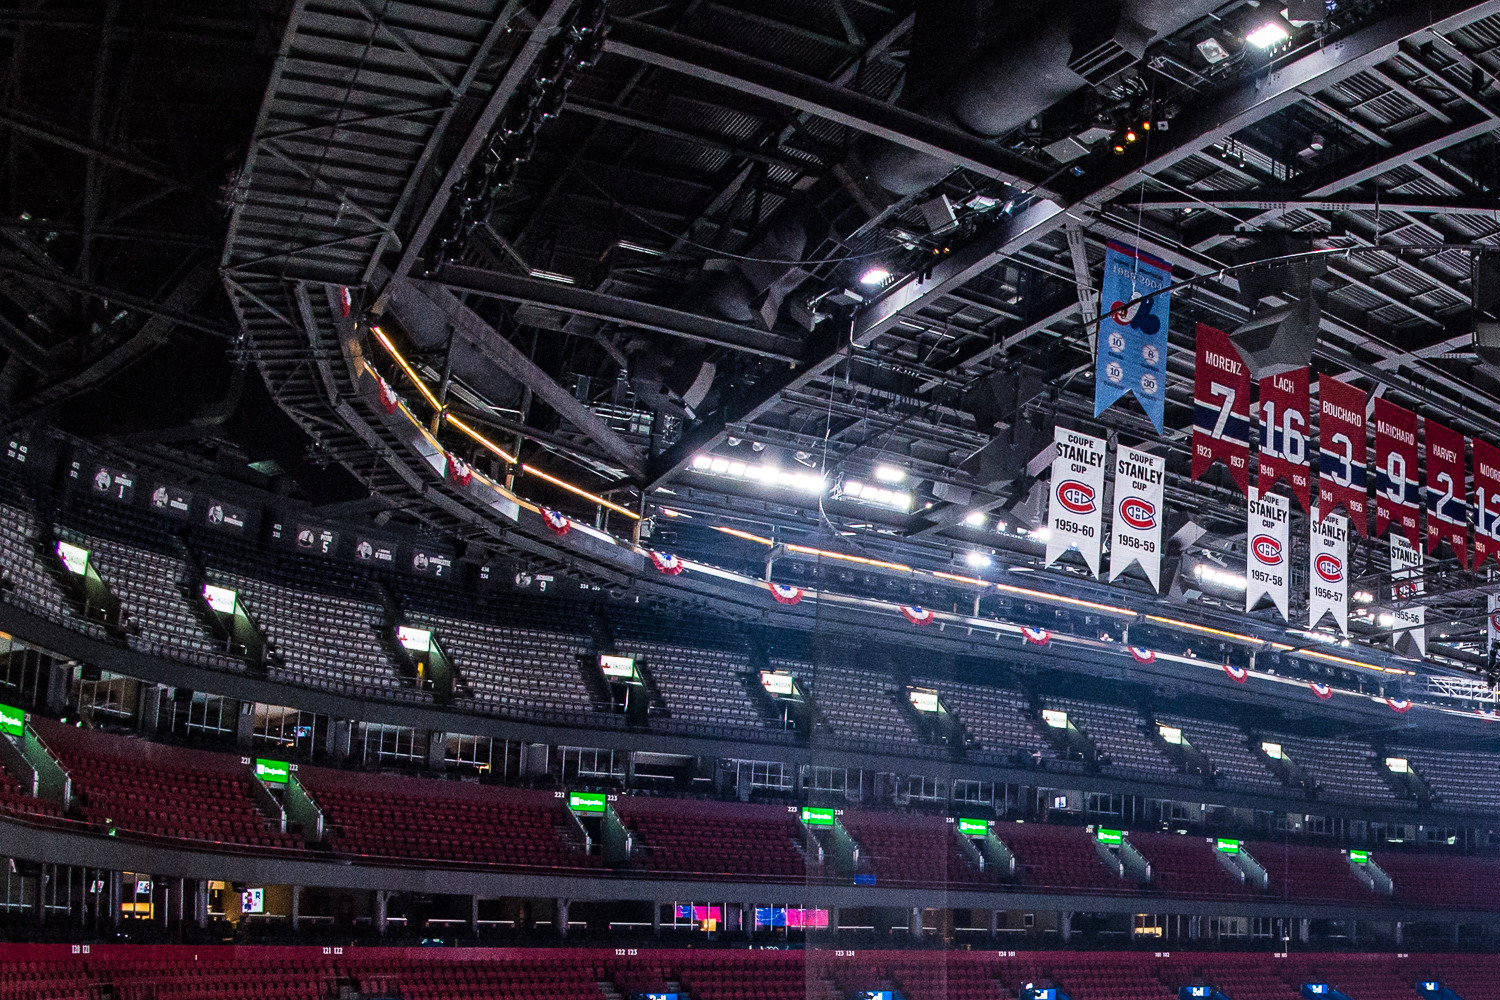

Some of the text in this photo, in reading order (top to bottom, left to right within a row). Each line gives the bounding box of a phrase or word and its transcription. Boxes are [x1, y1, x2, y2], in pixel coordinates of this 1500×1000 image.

[1112, 338, 1122, 347] 10
[1148, 350, 1154, 359] 8
[1205, 351, 1242, 376] MORENZ
[1110, 367, 1120, 377] 10
[1144, 379, 1155, 389] 30
[1273, 375, 1295, 394] LACH
[1210, 381, 1236, 440] 7
[1323, 401, 1362, 427] BOUCHARD
[1067, 434, 1094, 448] COUPE
[1262, 400, 1306, 465] 16
[1056, 442, 1103, 468] STANLEY
[1129, 452, 1154, 466] COUPE
[1196, 444, 1245, 469] 1923 1937
[1331, 432, 1352, 488] 3
[1433, 443, 1457, 464] HARVEY
[1070, 464, 1087, 474] CUP
[1118, 460, 1163, 485] STANLEY
[1260, 464, 1306, 487] 1940 1954
[1386, 451, 1406, 504] 9
[1132, 480, 1147, 491] CUP
[1436, 471, 1454, 524] 2
[1250, 500, 1287, 523] STANLEY
[1055, 518, 1095, 538] 1959-60
[1262, 519, 1275, 529] CUP
[1312, 520, 1346, 542] STANLEY
[322, 541, 329, 553] 5
[1118, 534, 1155, 552] 1958-59
[1324, 538, 1335, 548] CUP
[1391, 546, 1422, 566] STANLEY
[436, 565, 443, 576] 2
[1251, 569, 1283, 587] 1957-58
[540, 581, 547, 592] 9
[1314, 586, 1343, 602] 1956-57
[1394, 610, 1420, 624] 1955-56
[72, 945, 90, 954] 120 121
[1192, 987, 1204, 996] Bell
